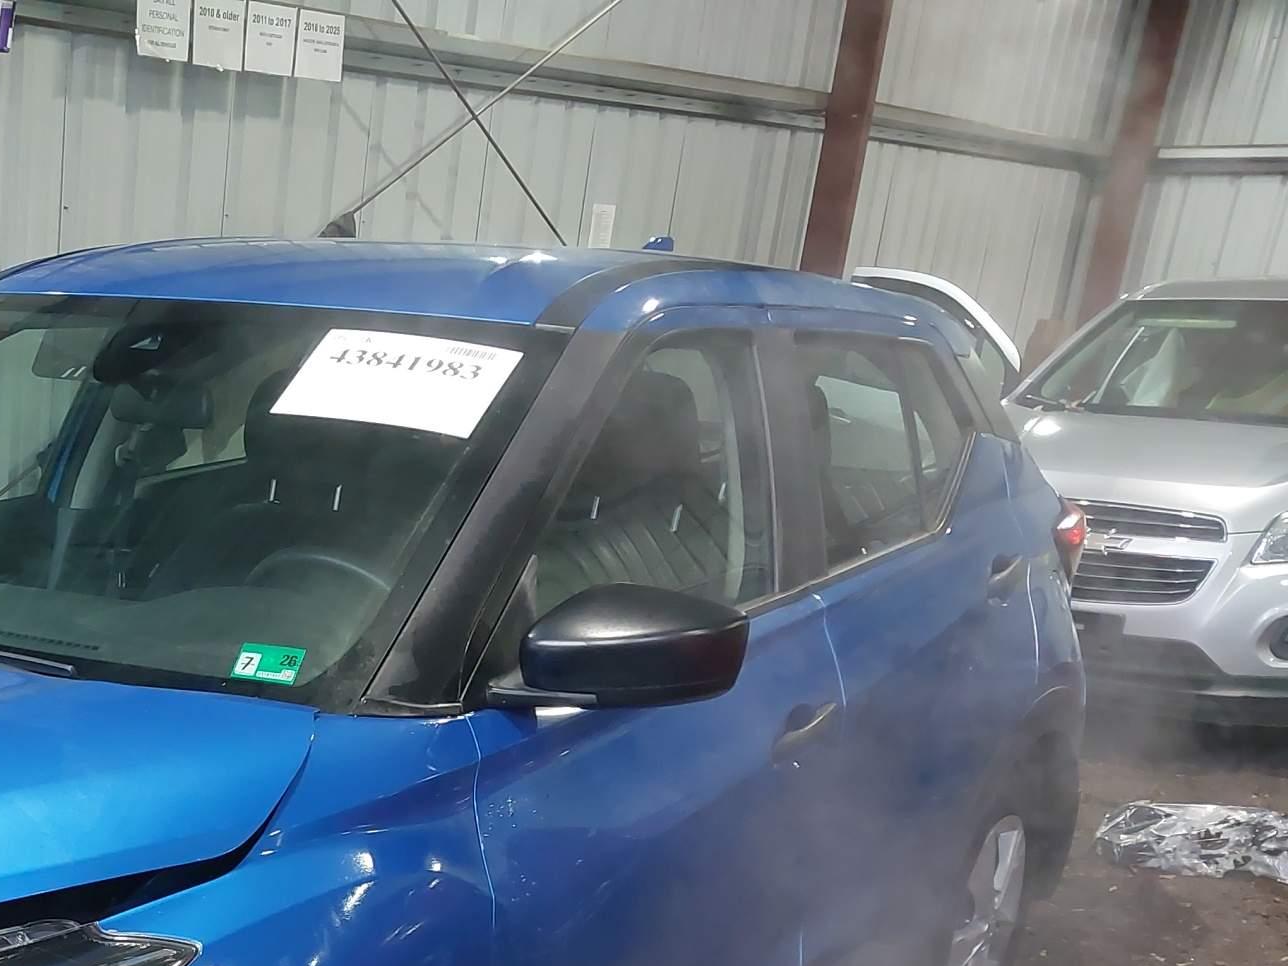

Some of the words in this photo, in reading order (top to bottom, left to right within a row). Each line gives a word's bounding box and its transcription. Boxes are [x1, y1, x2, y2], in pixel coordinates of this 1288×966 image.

[215, 9, 221, 19] &
[223, 10, 240, 21] older
[252, 13, 267, 25] 2011
[268, 16, 274, 26] to
[275, 17, 292, 28] 2017
[329, 348, 483, 380] 43841983
[241, 656, 254, 671] 7
